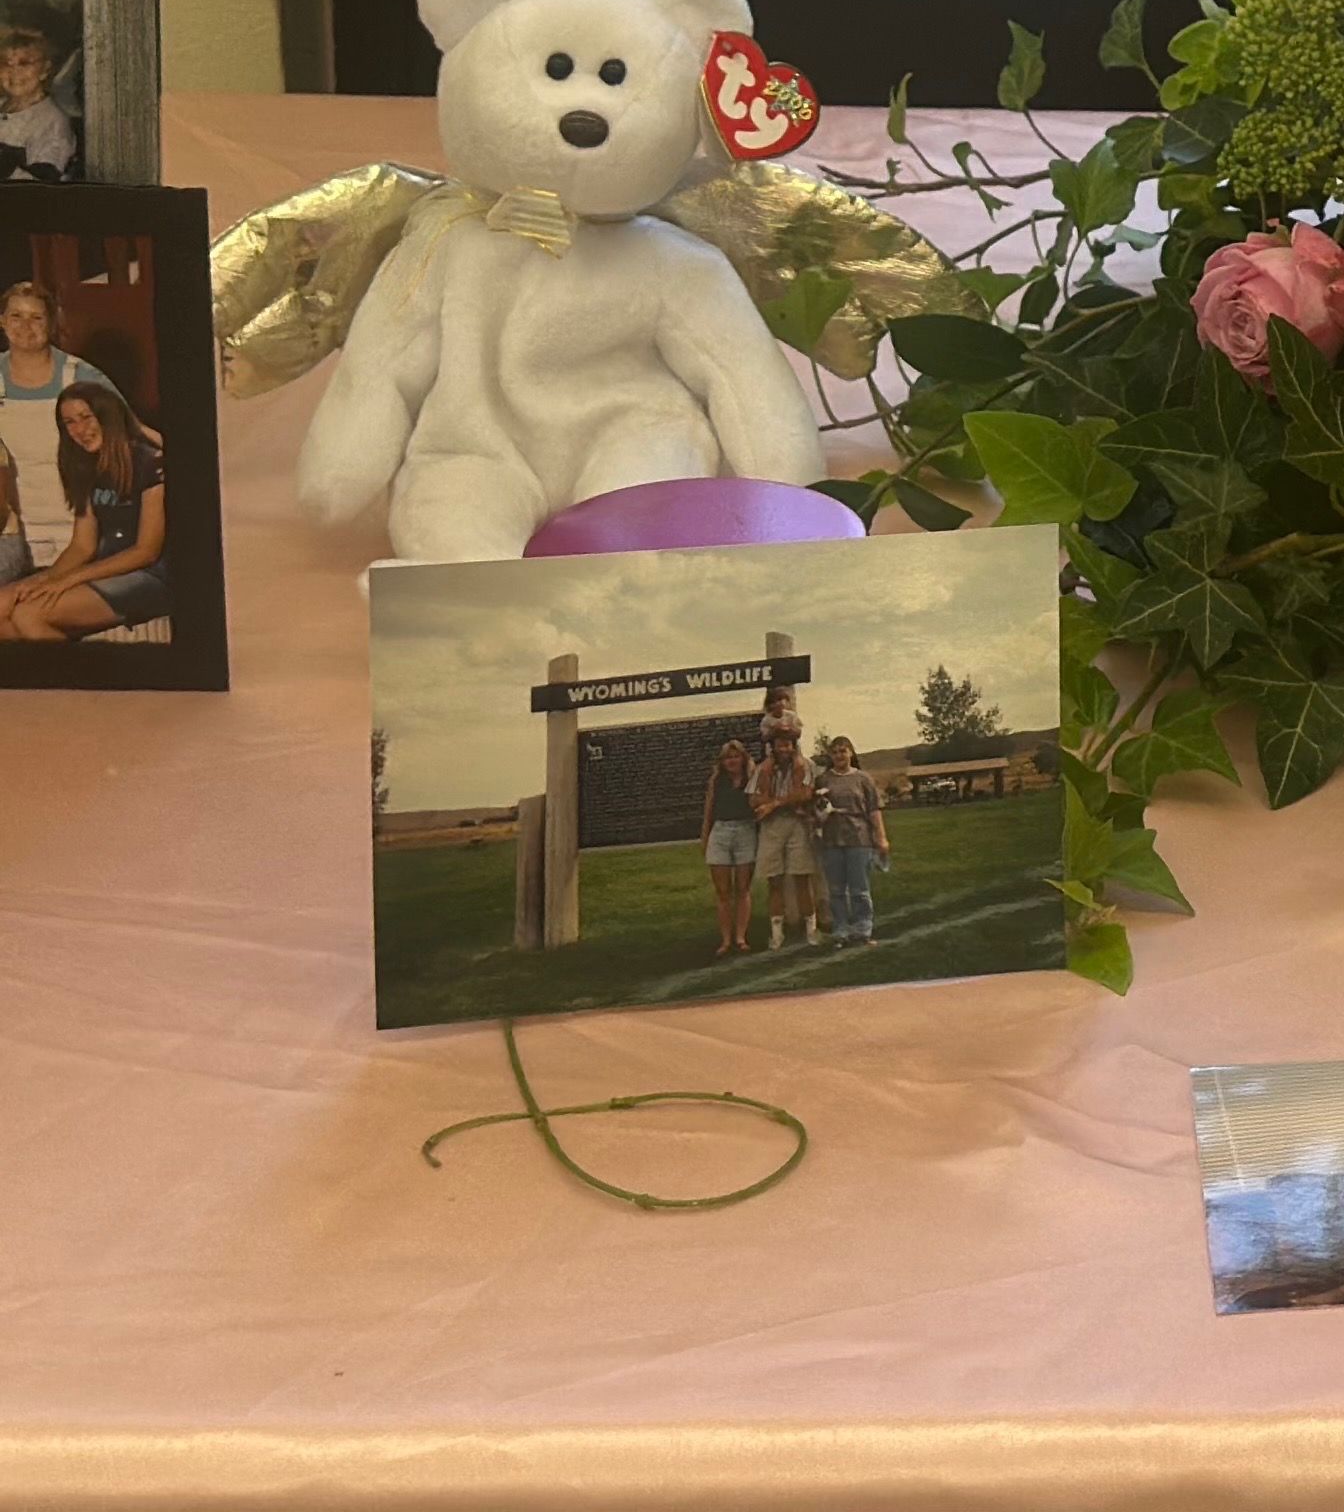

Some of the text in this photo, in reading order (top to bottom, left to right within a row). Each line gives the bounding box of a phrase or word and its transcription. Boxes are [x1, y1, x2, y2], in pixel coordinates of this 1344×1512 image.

[716, 52, 789, 149] ty
[762, 80, 812, 121] 2000
[567, 665, 773, 703] WYOMING'S WILDLIFE
